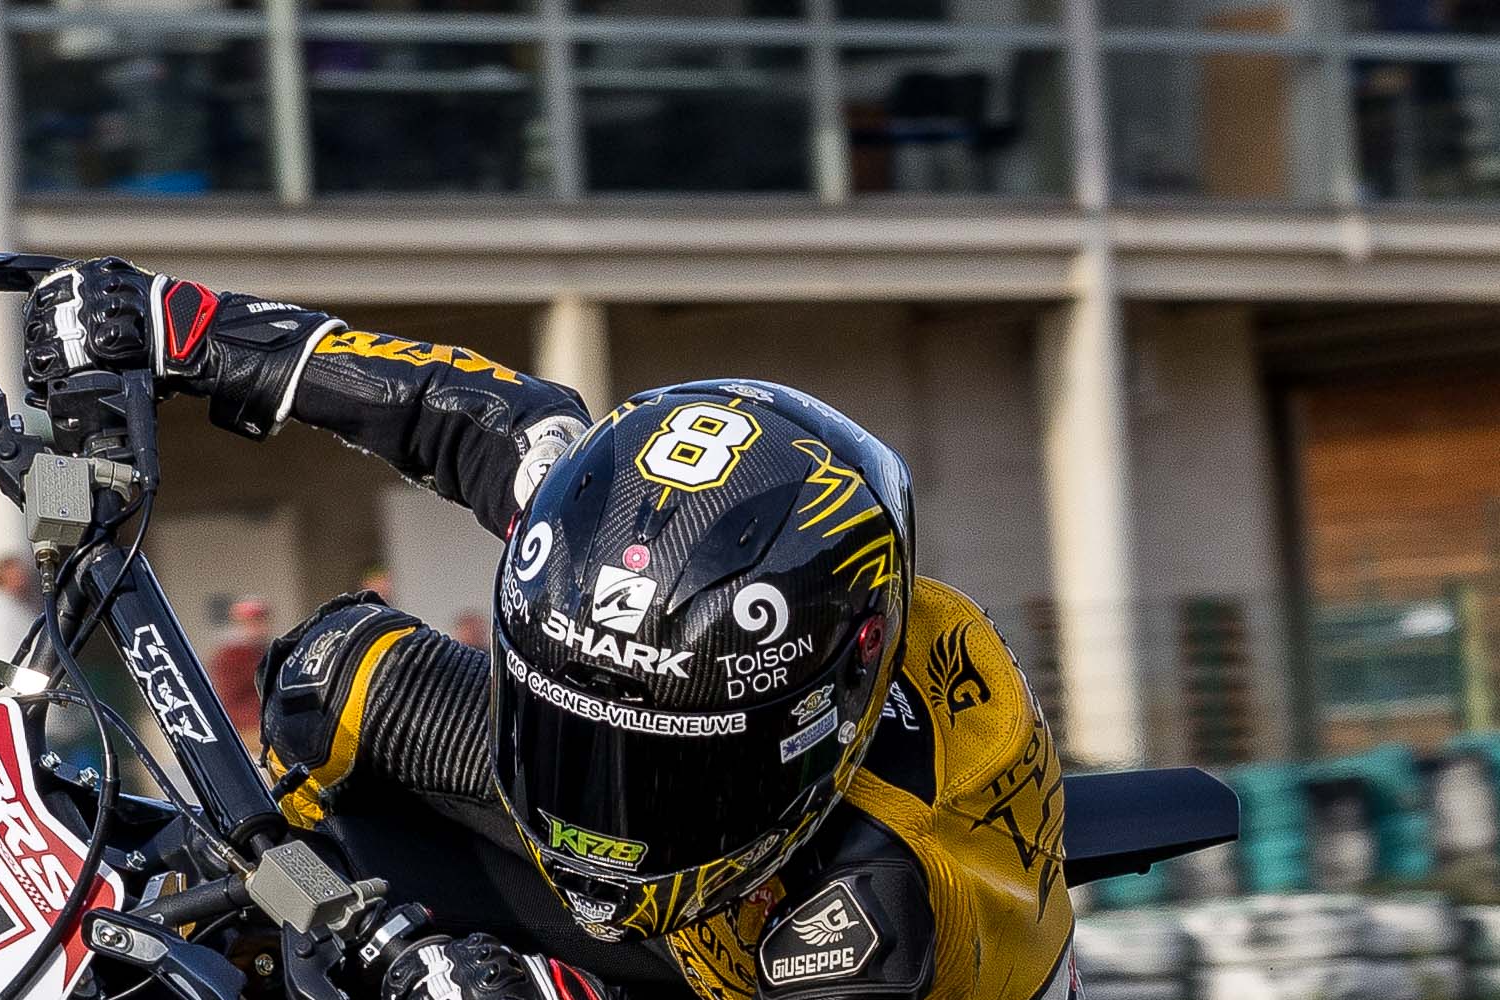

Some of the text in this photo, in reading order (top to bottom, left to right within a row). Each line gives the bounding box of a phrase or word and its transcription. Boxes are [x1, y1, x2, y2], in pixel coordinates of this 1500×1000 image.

[640, 404, 757, 489] 8
[504, 563, 531, 625] OISON
[542, 608, 695, 679] SHARK
[717, 634, 814, 677] TOISON
[507, 650, 527, 682] MC
[528, 671, 747, 736] CAGNES-VILLENEUVE
[727, 667, 788, 699] D'OR
[551, 820, 645, 863] KF78
